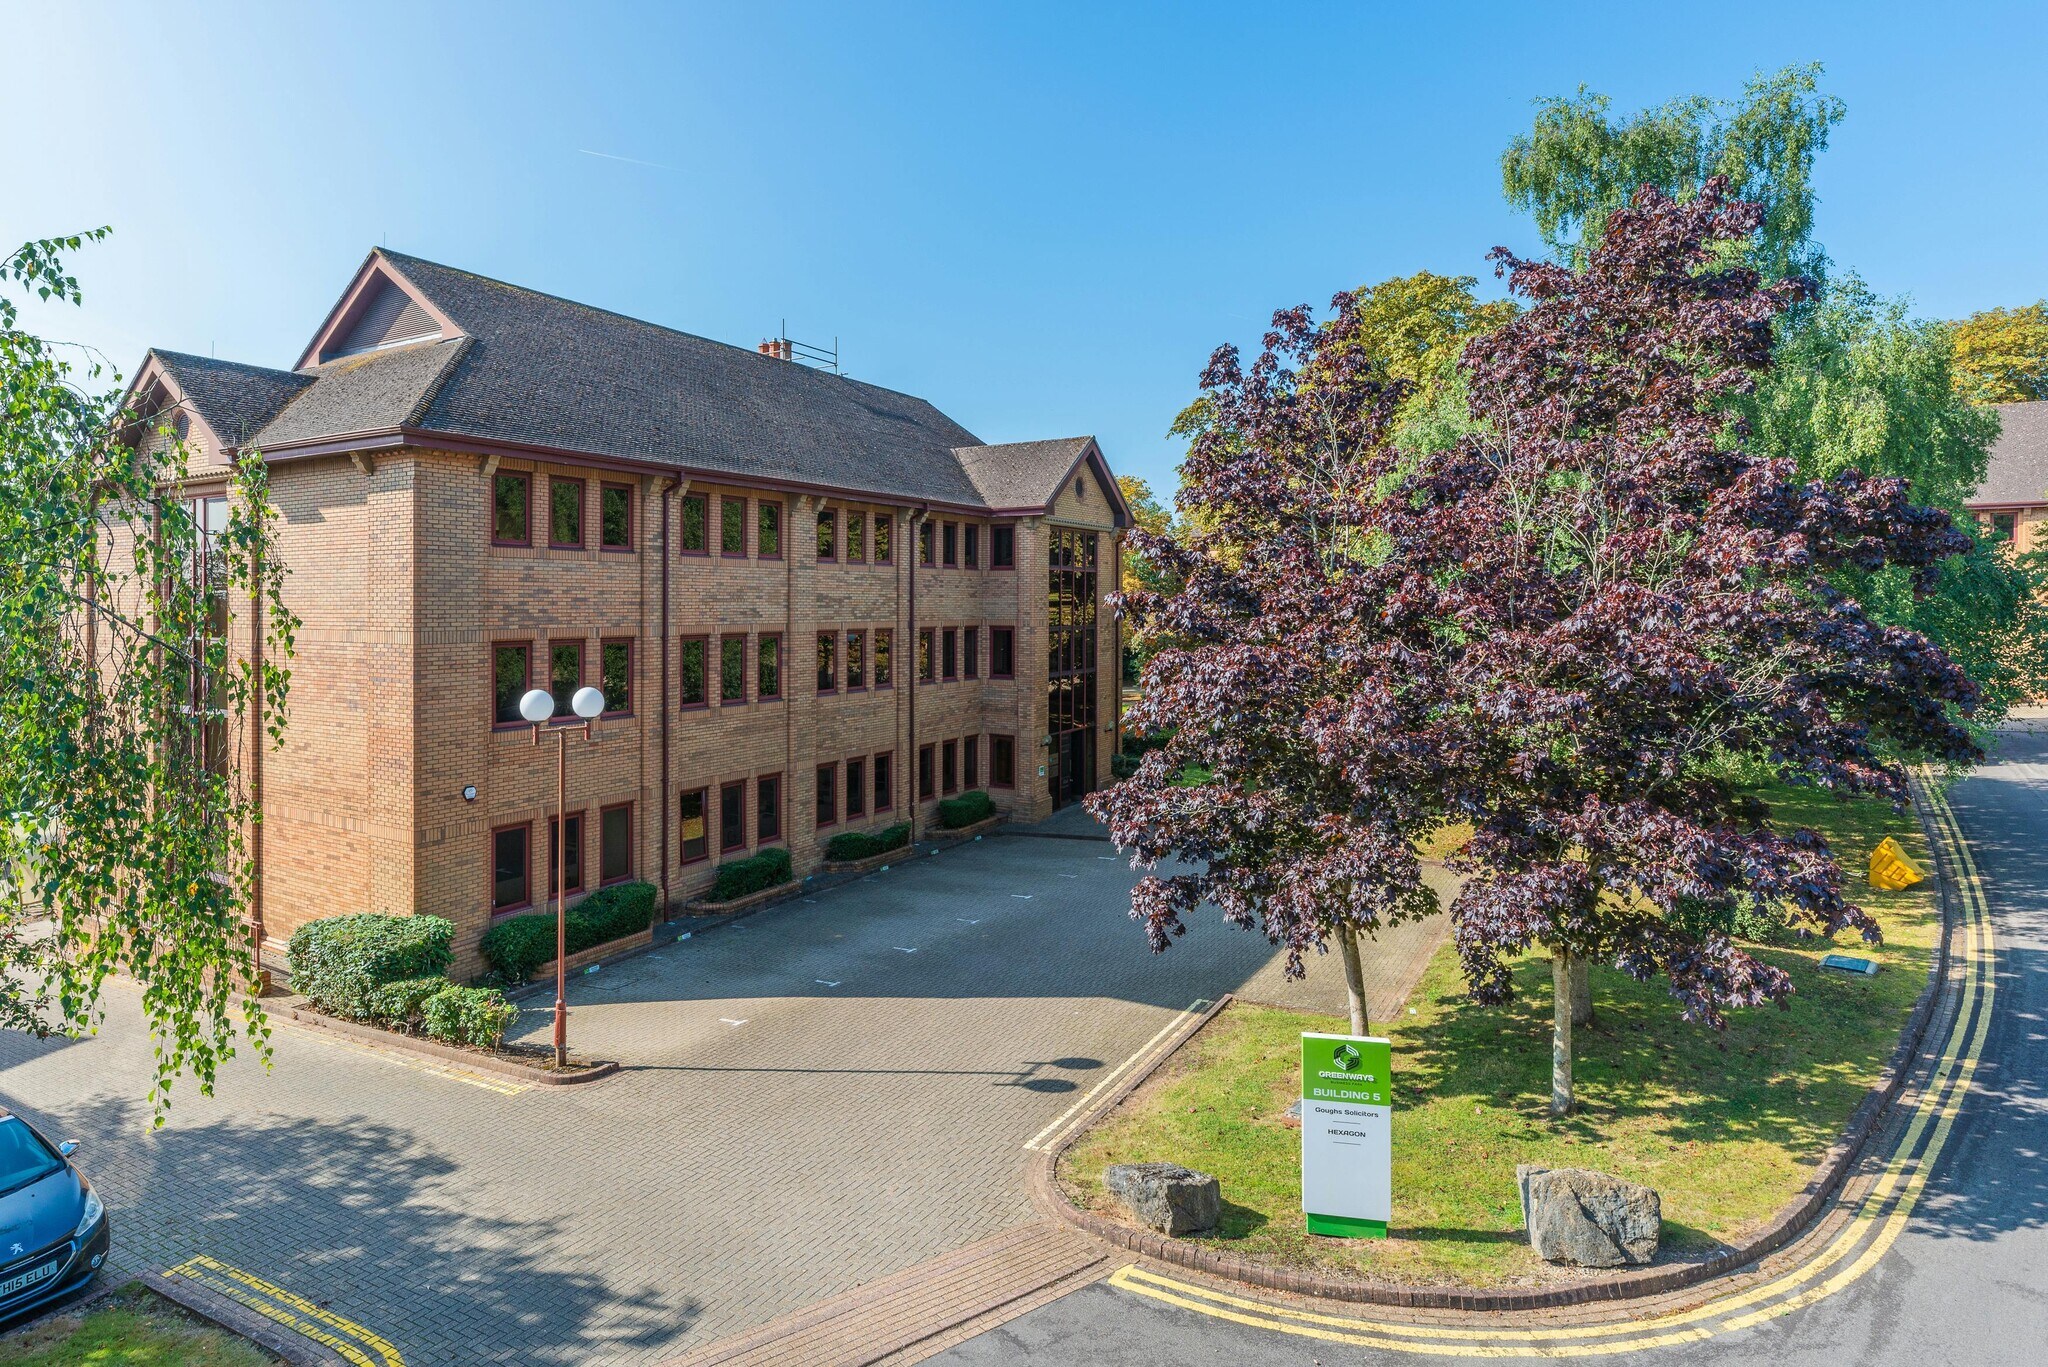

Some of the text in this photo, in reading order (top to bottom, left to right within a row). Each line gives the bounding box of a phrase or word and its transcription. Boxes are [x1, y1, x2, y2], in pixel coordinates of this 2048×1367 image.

[1319, 1071, 1374, 1082] GREENWAYS
[1313, 1088, 1381, 1101] BUILDING 5
[1315, 1107, 1379, 1118] Goughs Solicitors
[1328, 1129, 1366, 1138] HEXAGON
[0, 1265, 51, 1294] H15 ELU
